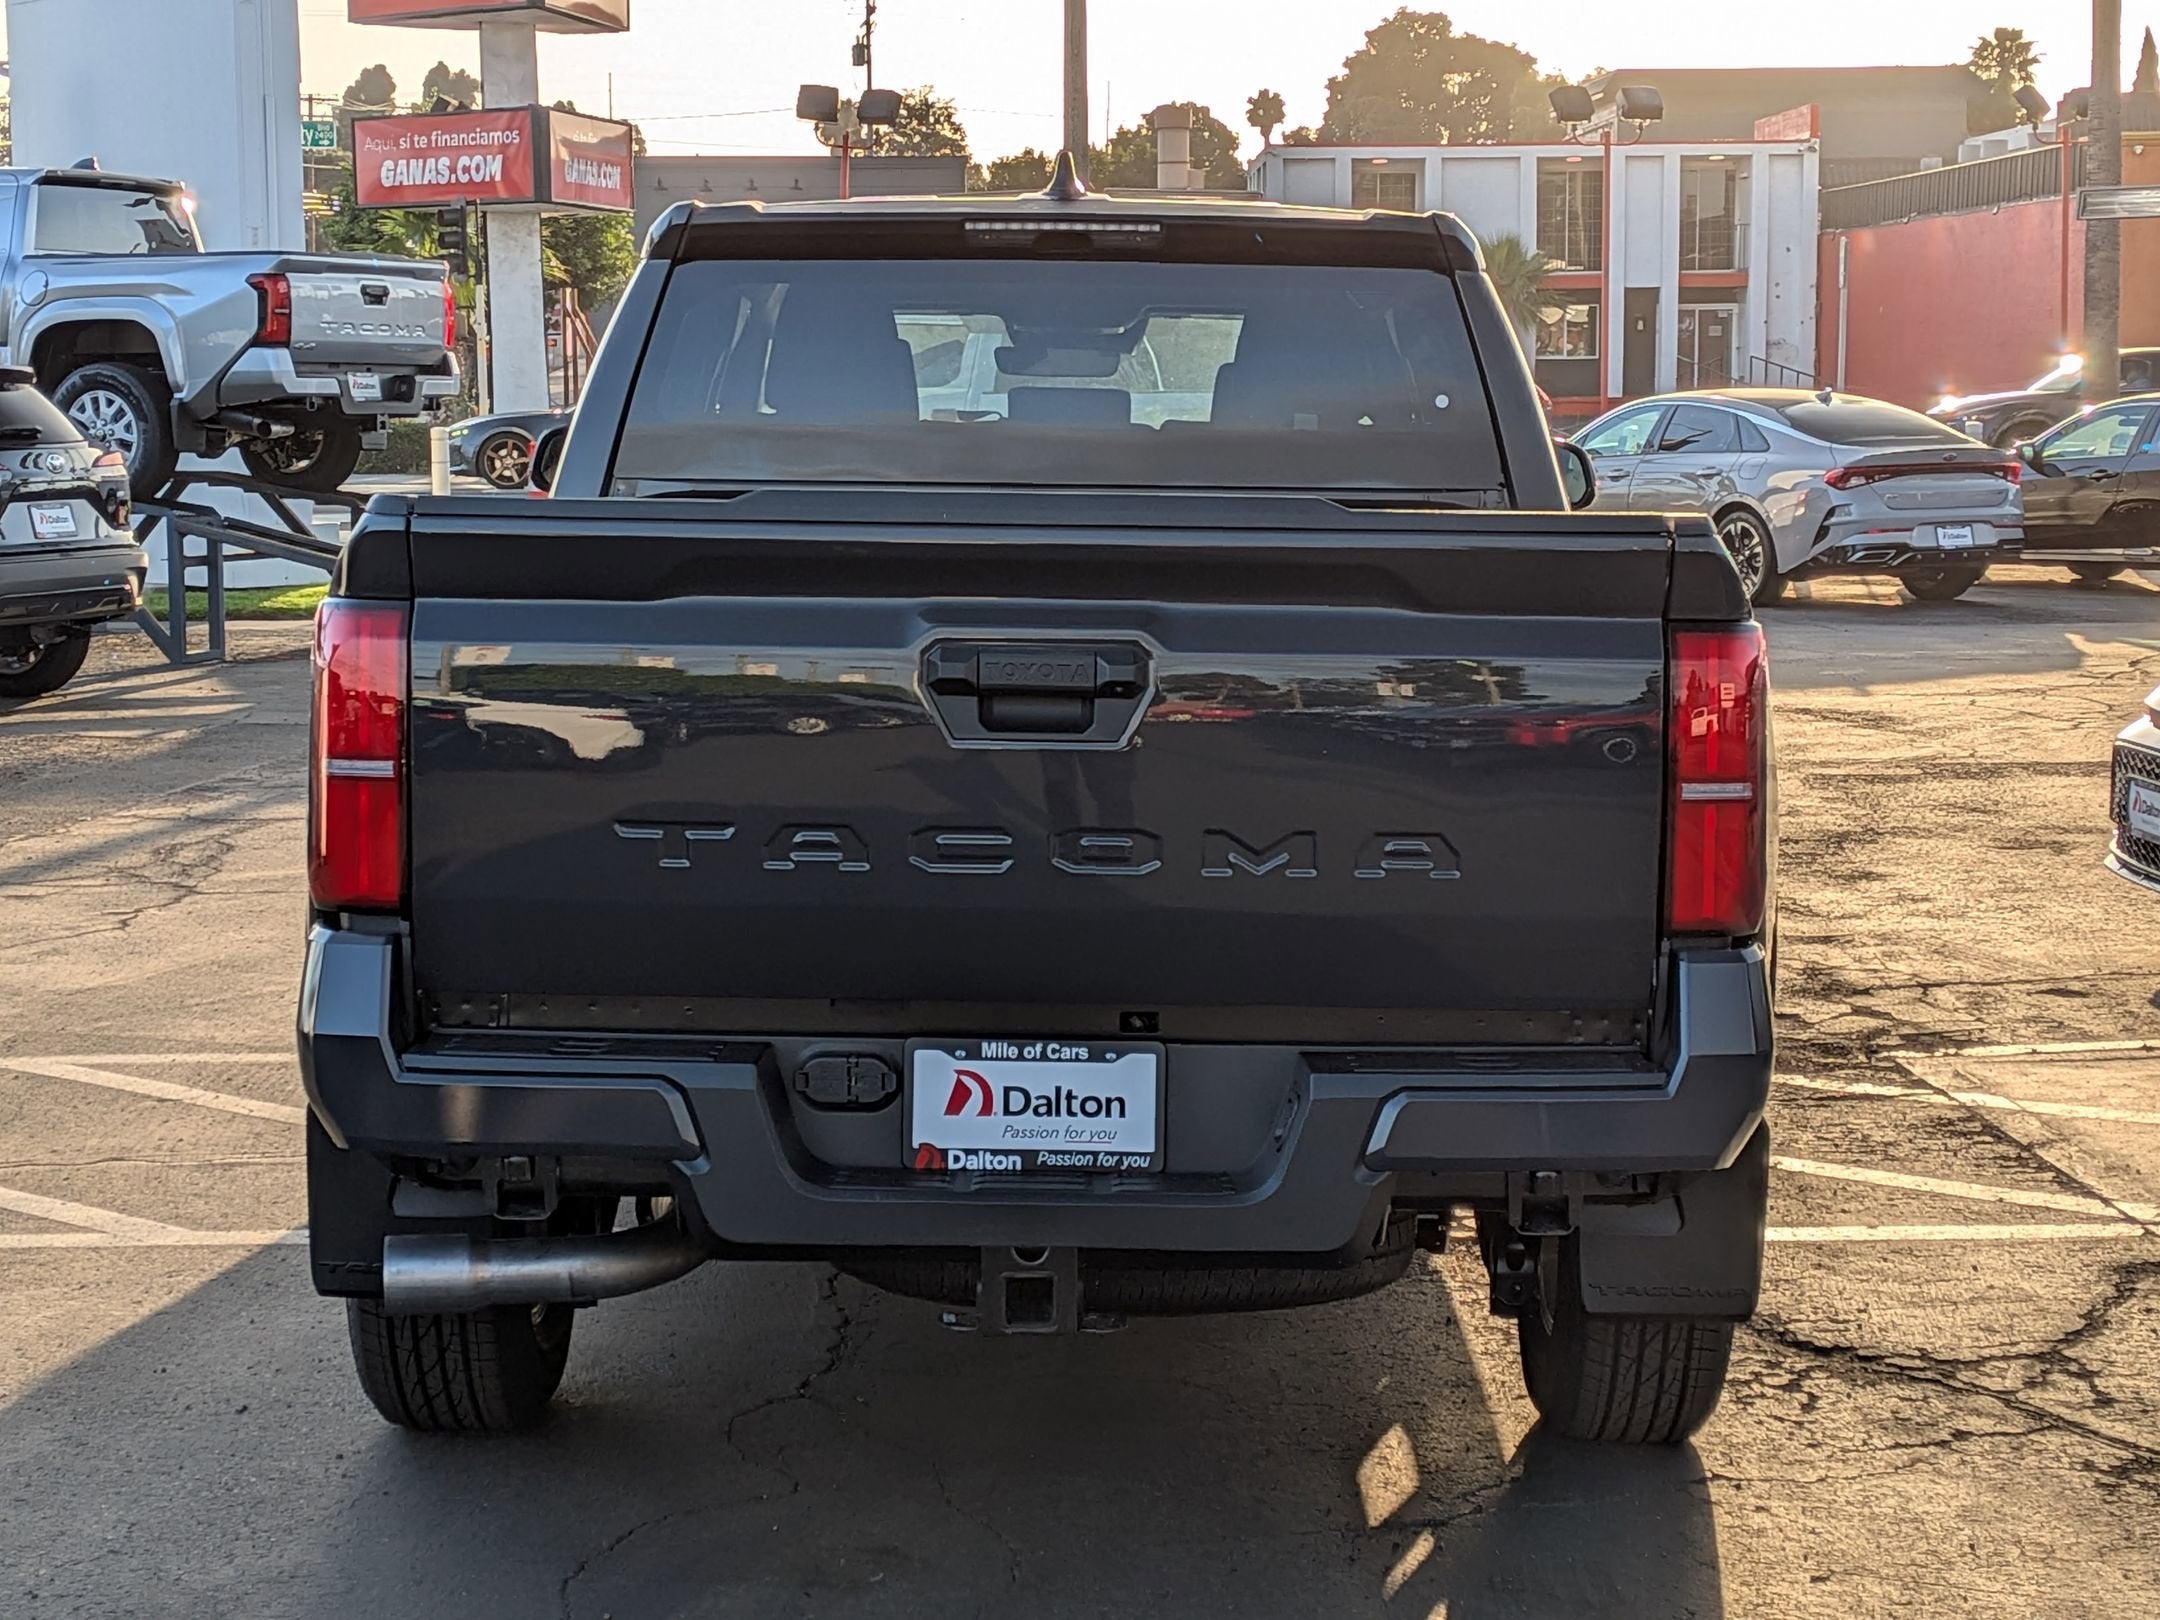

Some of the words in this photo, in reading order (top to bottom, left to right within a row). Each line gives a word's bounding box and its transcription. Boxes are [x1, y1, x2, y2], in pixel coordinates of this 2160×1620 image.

[400, 133, 411, 149] sí
[414, 134, 428, 148] te
[431, 127, 520, 148] financiamos
[380, 153, 504, 188] GANAS.COM
[565, 158, 621, 190] GANAS.COM
[320, 320, 426, 337] TACOMA
[985, 662, 1090, 683] TOYOTA
[613, 821, 1463, 877] TACOMA
[981, 1042, 1018, 1059] Mile
[1023, 1042, 1043, 1059] of
[1046, 1044, 1089, 1061] Cars
[1002, 1085, 1126, 1119] Dalton
[1002, 1125, 1060, 1140] Passion
[1064, 1126, 1086, 1142] for
[1088, 1130, 1118, 1144] you
[947, 1150, 1022, 1171] Dalton
[1037, 1151, 1093, 1167] Passion
[1097, 1151, 1117, 1168] for
[1119, 1154, 1151, 1170] you
[1588, 1284, 1752, 1298] TACOMA
